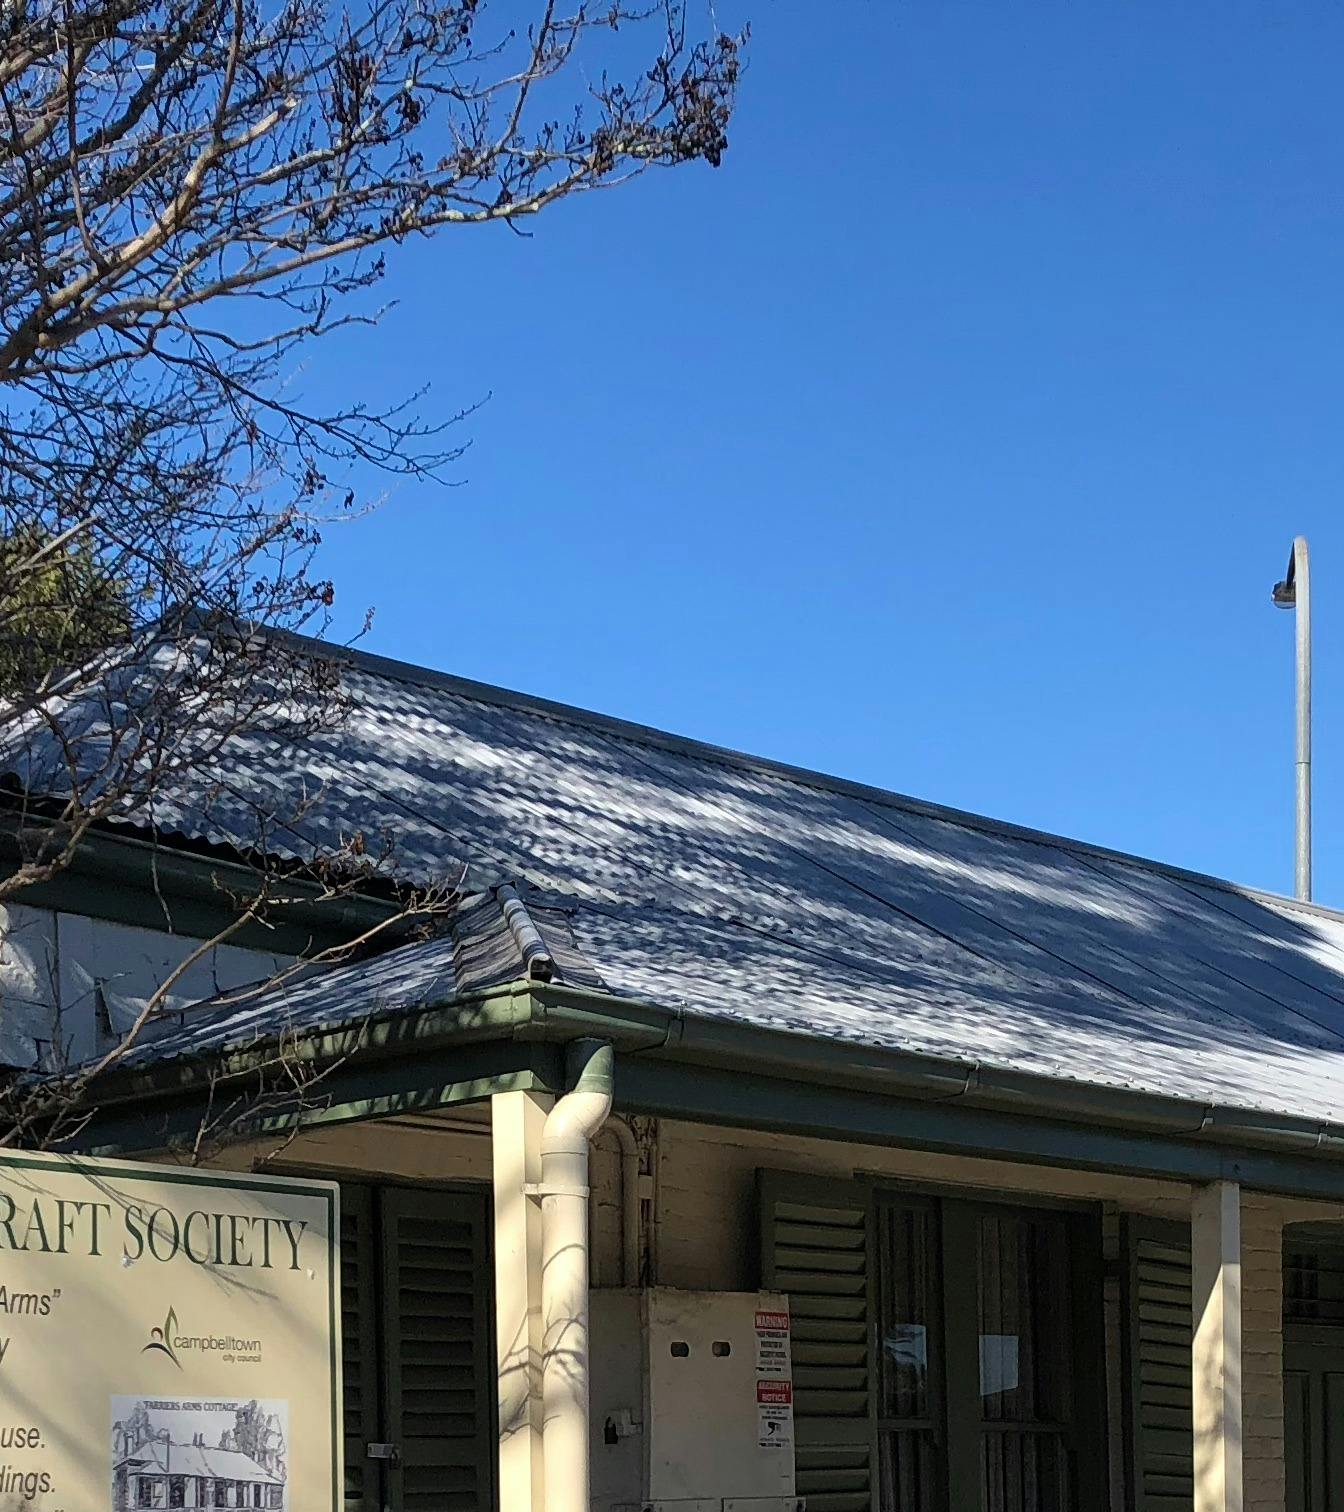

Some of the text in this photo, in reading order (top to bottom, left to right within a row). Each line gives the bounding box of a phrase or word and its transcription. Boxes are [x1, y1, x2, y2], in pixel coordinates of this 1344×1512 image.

[122, 1205, 308, 1270] SOCIETY
[756, 1315, 787, 1329] WARNING
[173, 1334, 262, 1353] campbelltown
